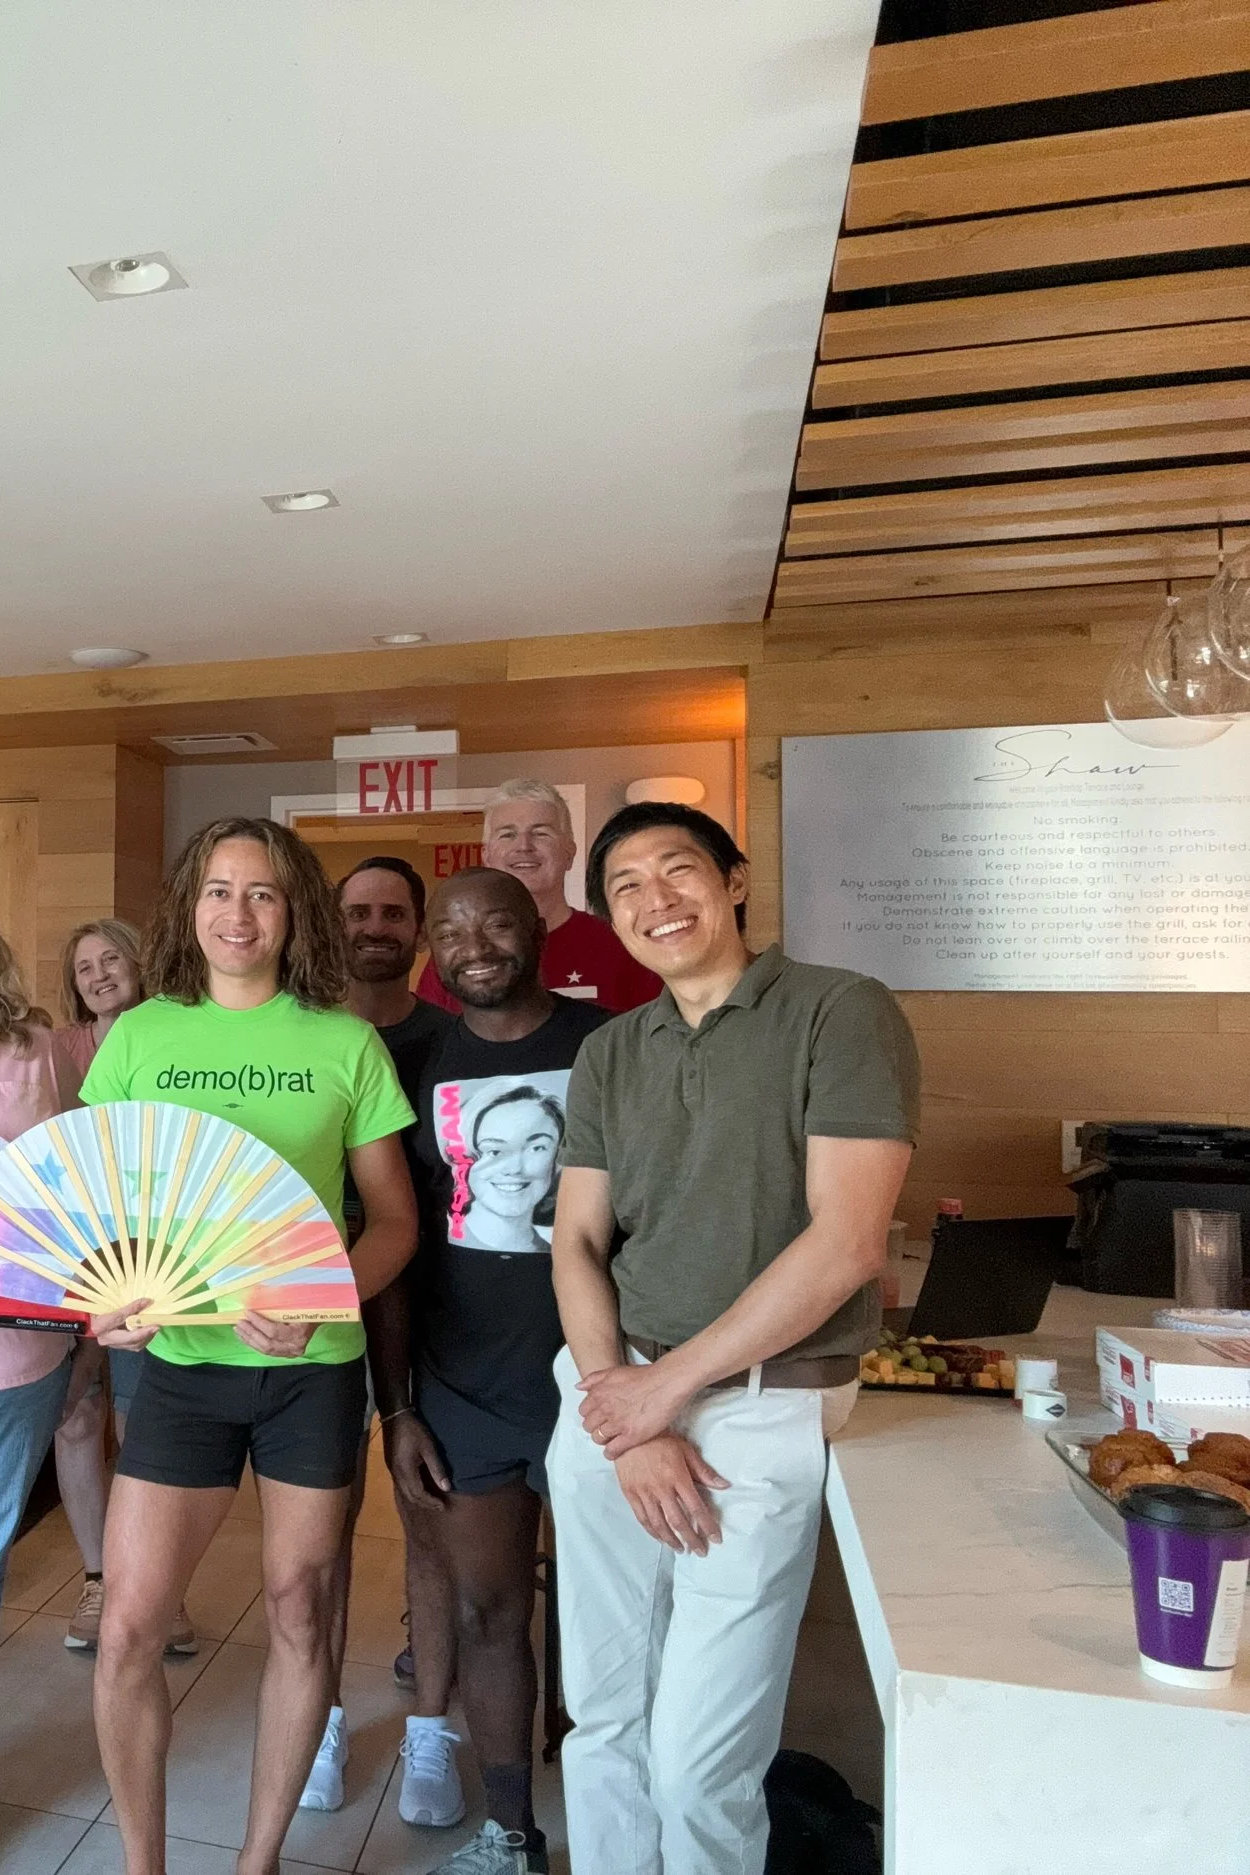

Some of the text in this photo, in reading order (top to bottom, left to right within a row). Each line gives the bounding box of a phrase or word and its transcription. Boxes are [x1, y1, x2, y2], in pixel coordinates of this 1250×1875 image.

[974, 729, 1181, 782] Shaw
[359, 759, 438, 814] EXIT
[1033, 815, 1123, 827] No smoking.
[941, 833, 957, 842] Be
[962, 832, 1034, 842] courteous
[1038, 830, 1064, 840] and
[1071, 828, 1143, 842] respectful
[1149, 829, 1163, 839] to
[912, 848, 973, 858] Obscene
[978, 847, 1005, 857] and
[1010, 845, 1075, 856] offensive
[1080, 843, 1148, 855] language
[1153, 844, 1164, 852] is
[434, 844, 484, 878] EXIT
[985, 861, 1021, 872] Keep
[1026, 860, 1064, 870] noise
[1070, 860, 1083, 869] to
[1089, 861, 1097, 869] a
[840, 878, 864, 889] Any
[870, 878, 910, 889] usage
[914, 878, 929, 887] of
[933, 877, 958, 886] this
[963, 878, 1004, 887] space
[1189, 873, 1200, 883] is
[1205, 872, 1219, 883] at
[857, 892, 947, 904] Management
[953, 893, 963, 901] is
[968, 892, 991, 901] not
[996, 890, 1078, 902] responsible
[1084, 890, 1102, 899] for
[1108, 891, 1134, 900] any
[1140, 889, 1165, 899] lost
[1171, 890, 1185, 898] or
[883, 903, 1249, 917] Demonstrate extreme caution when operating the
[843, 921, 851, 930] If
[855, 922, 880, 932] you
[885, 921, 902, 931] do
[907, 921, 929, 930] not
[935, 920, 971, 930] know
[977, 920, 1006, 929] how
[1012, 920, 1026, 929] to
[1032, 920, 1092, 931] properly
[1098, 920, 1122, 929] use
[1128, 919, 1150, 929] the
[1192, 919, 1217, 928] ask
[1223, 918, 1242, 927] for
[903, 936, 921, 945] Do
[926, 936, 947, 945] not
[952, 935, 982, 945] lean
[987, 936, 1018, 945] over
[1024, 936, 1038, 944] or
[1043, 935, 1082, 944] climb
[1087, 936, 1119, 944] over
[1125, 935, 1149, 944] the
[1154, 935, 1209, 944] terrace
[936, 950, 976, 960] Clean
[981, 951, 998, 961] up
[1003, 950, 1037, 959] after
[1042, 949, 1101, 961] yourself
[1105, 950, 1133, 959] and
[1138, 951, 1171, 961] your
[156, 1064, 315, 1098] demo(b)rat
[16, 1318, 73, 1329] ClackThatFan.com
